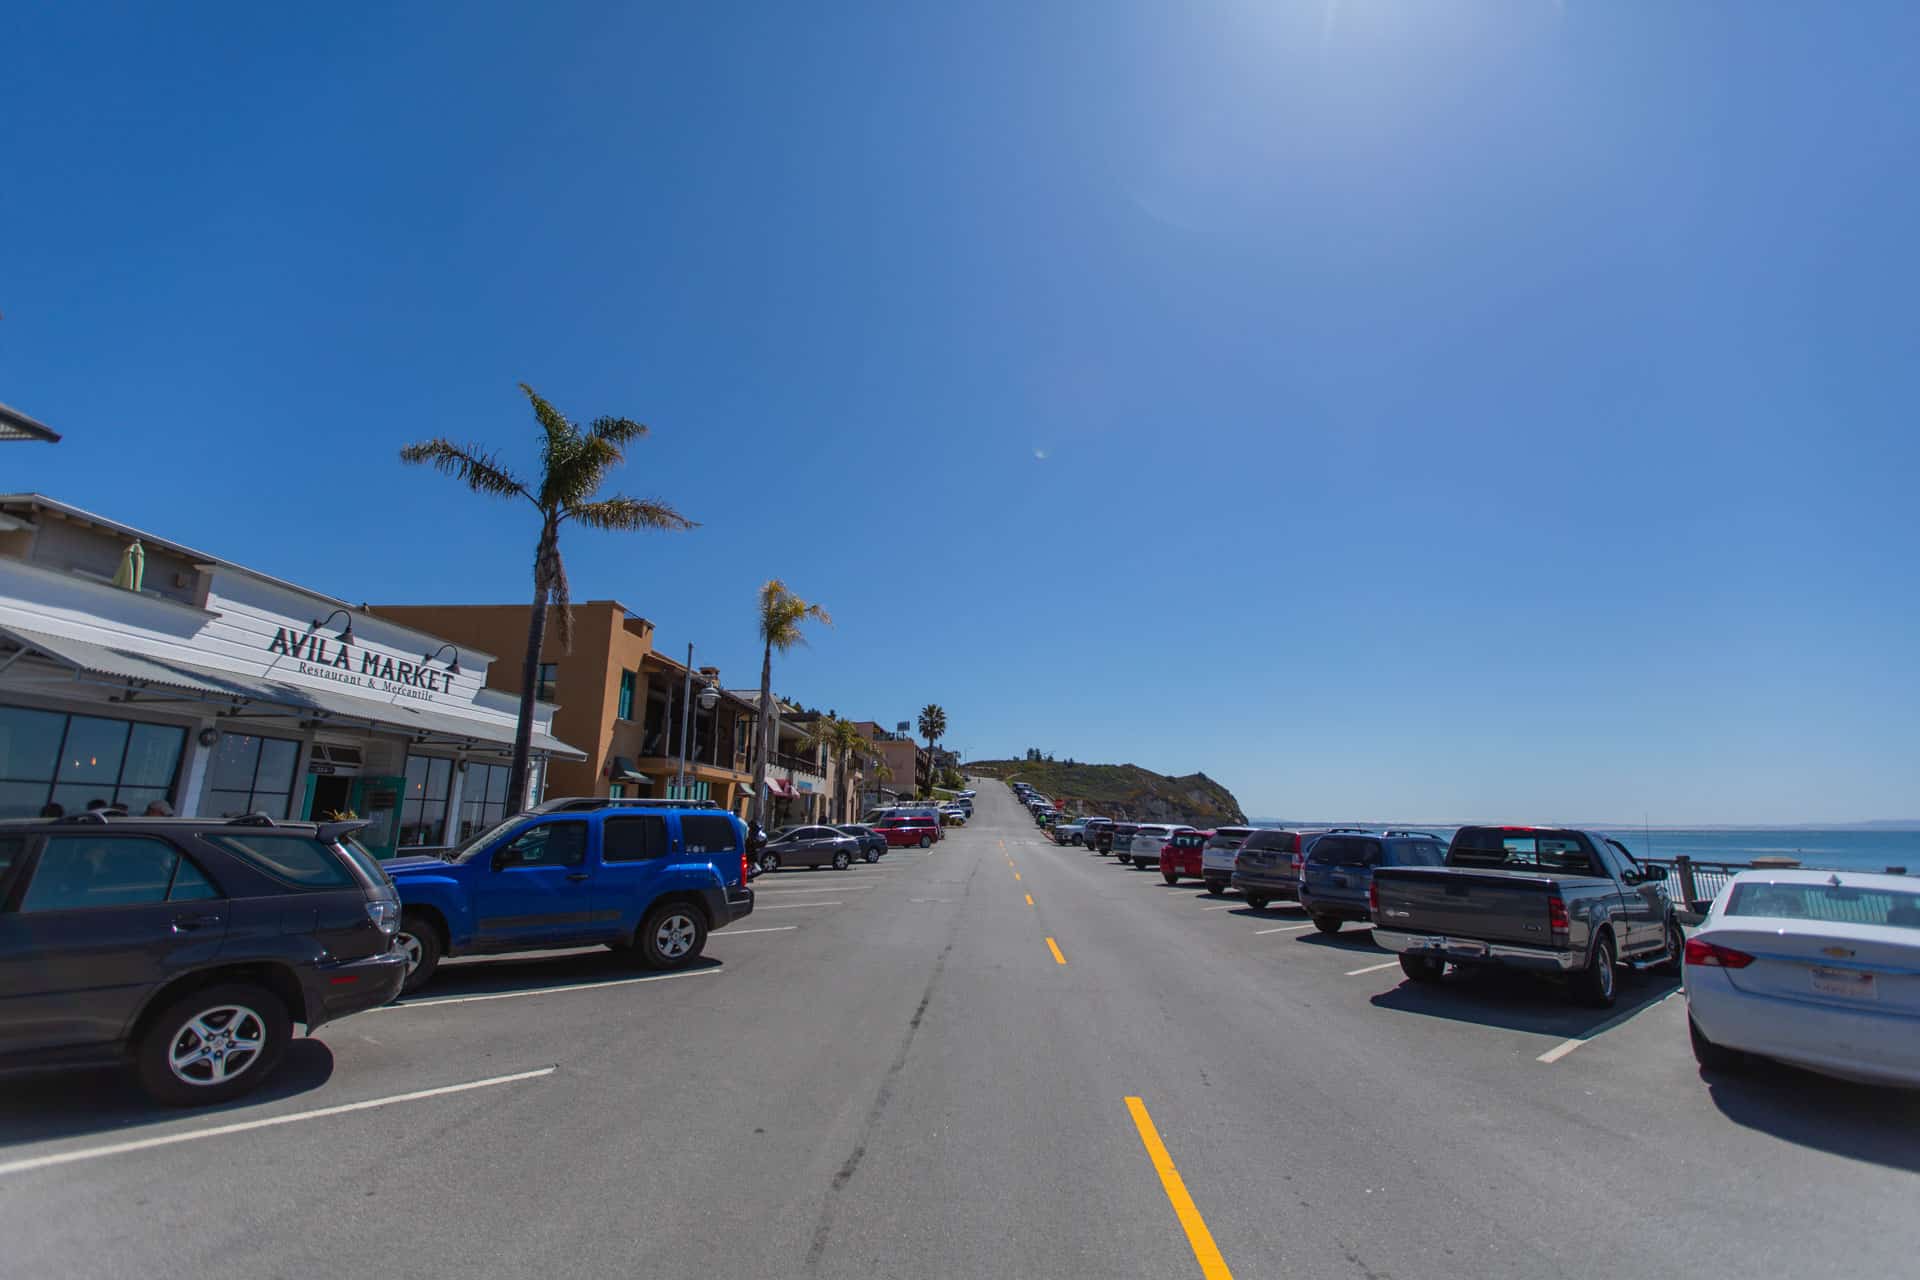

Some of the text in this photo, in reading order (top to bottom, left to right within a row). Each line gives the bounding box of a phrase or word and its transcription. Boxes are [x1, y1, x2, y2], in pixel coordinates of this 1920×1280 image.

[268, 627, 455, 694] AVILA MARKET
[299, 661, 433, 702] Restaurant & Mercantile
